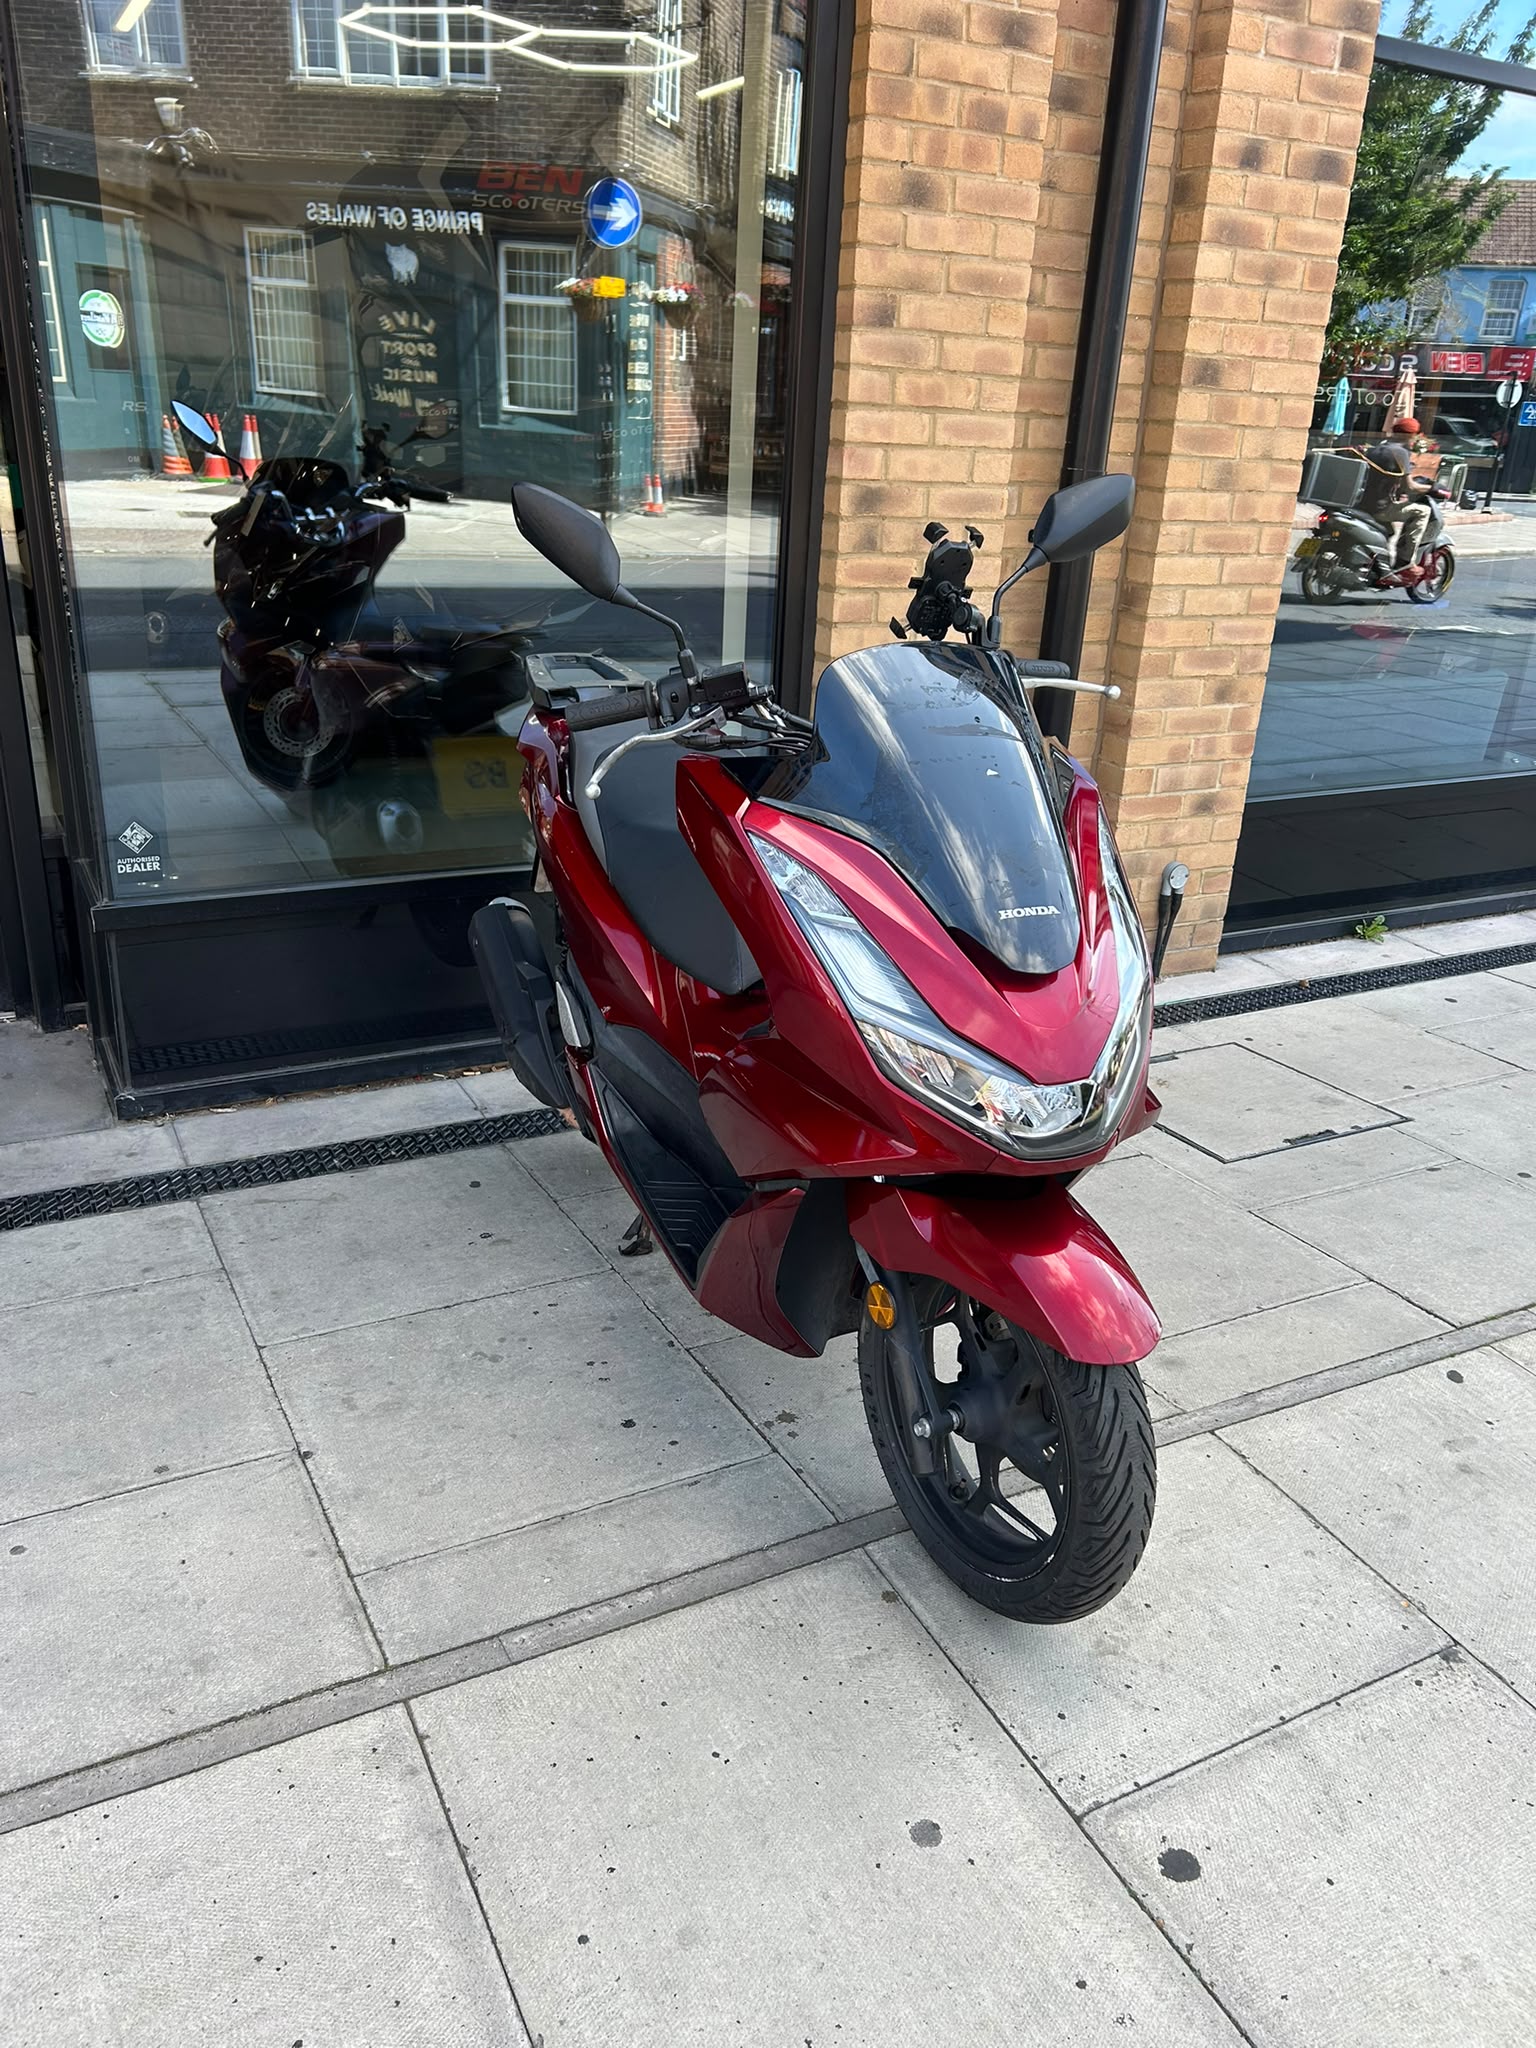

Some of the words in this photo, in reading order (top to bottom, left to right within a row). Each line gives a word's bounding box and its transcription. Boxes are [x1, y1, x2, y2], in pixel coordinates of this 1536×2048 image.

[477, 160, 584, 195] BEN
[117, 855, 160, 865] AUTHORISED
[117, 861, 161, 874] DEALER
[998, 905, 1061, 920] HONDA
